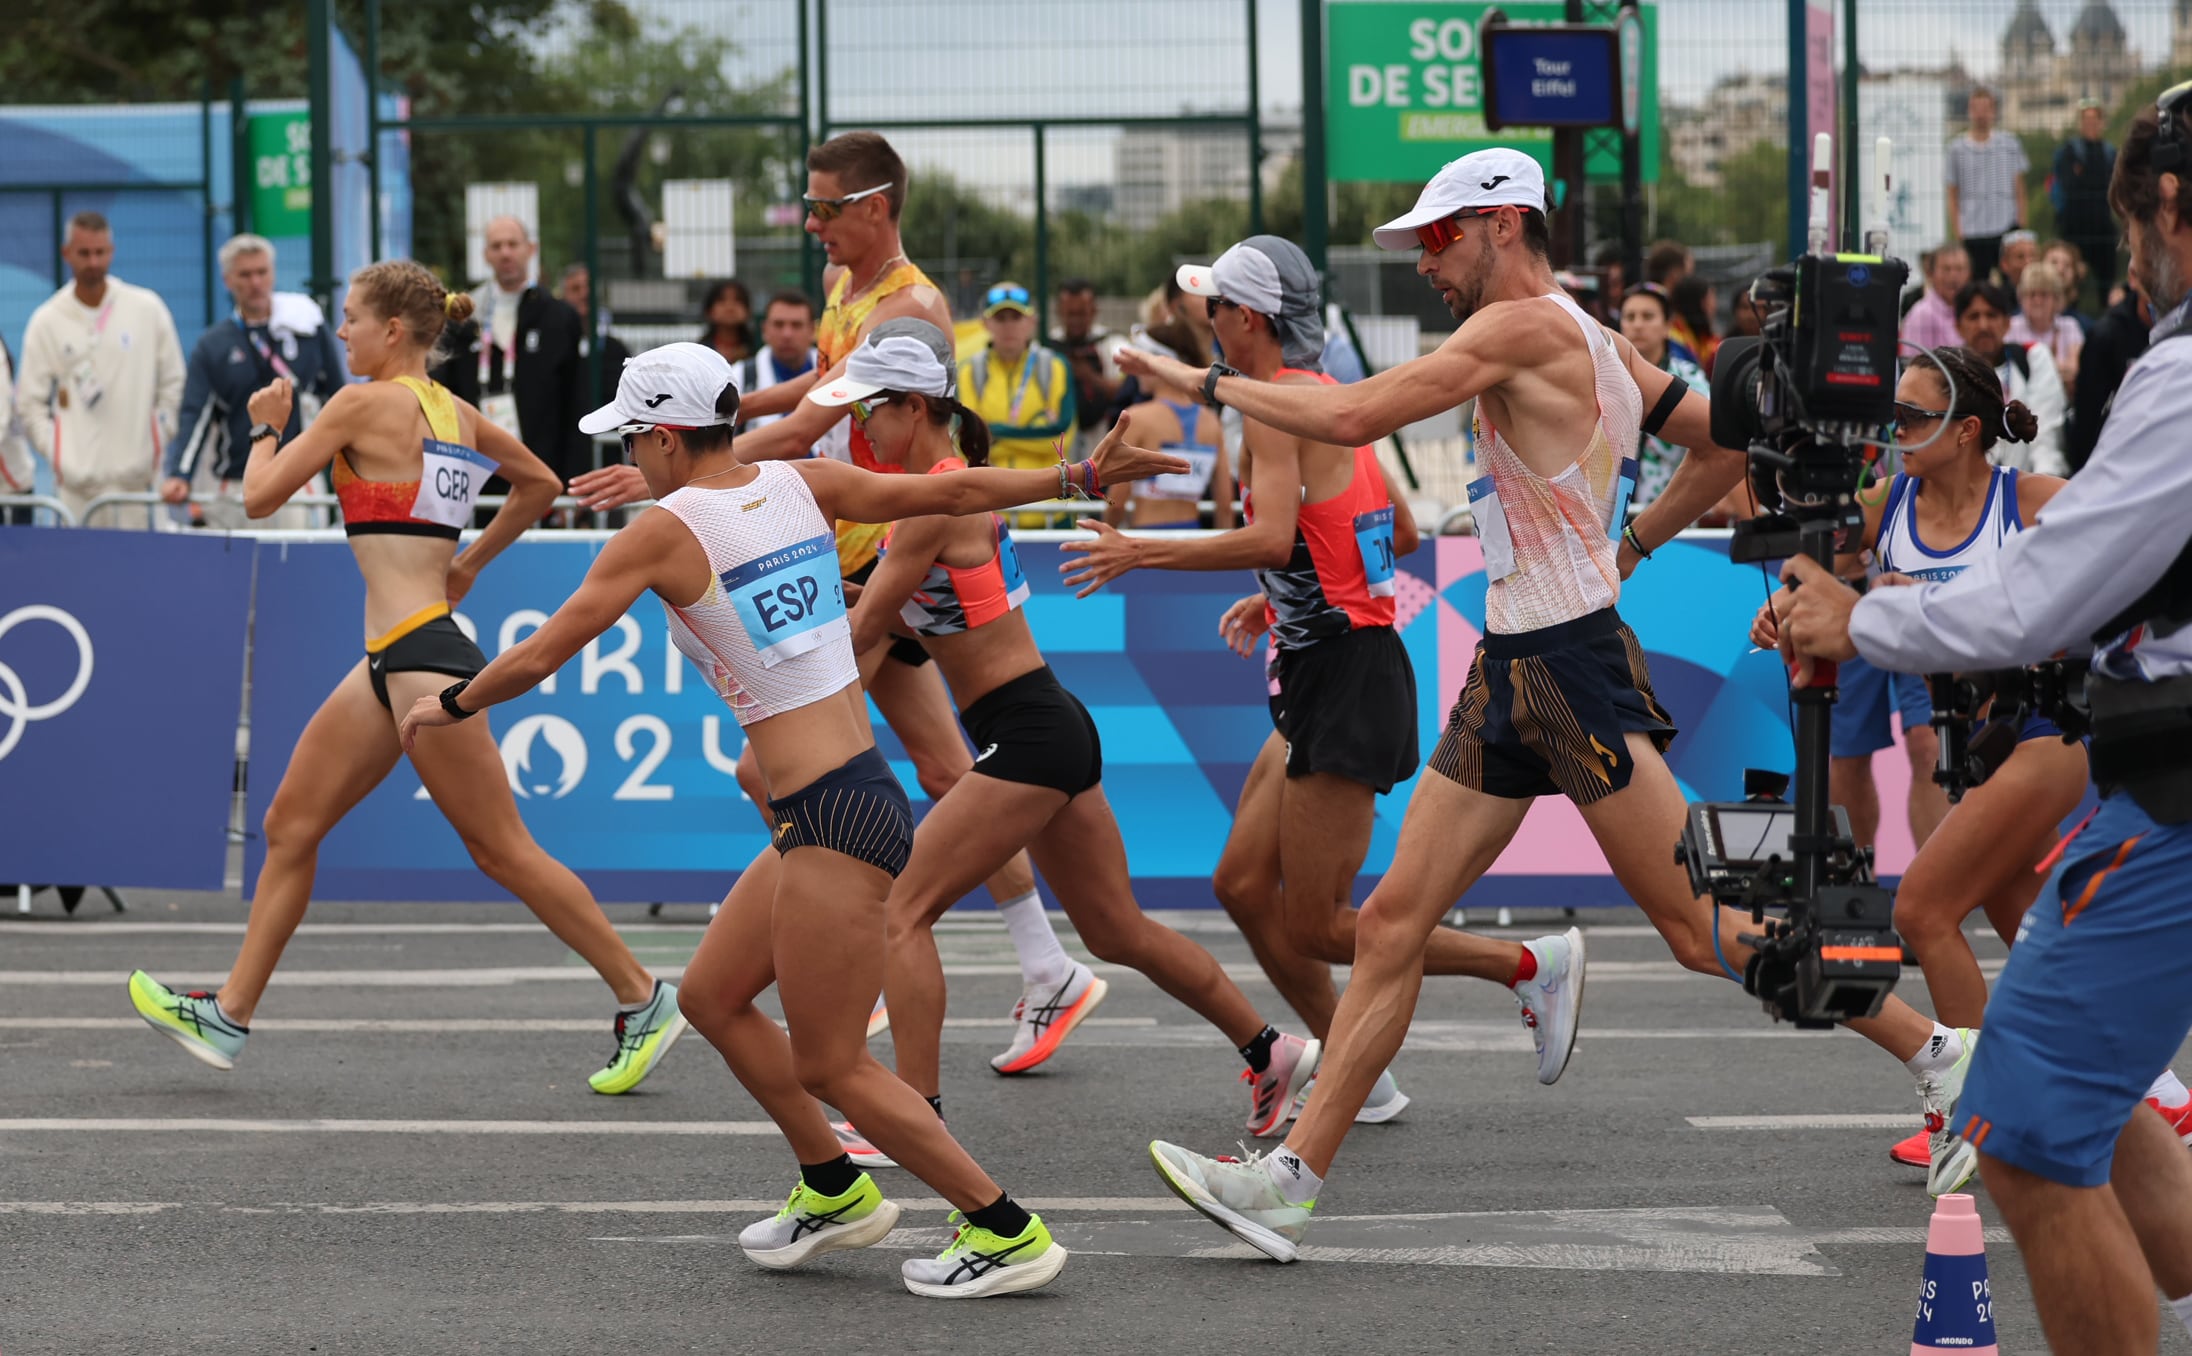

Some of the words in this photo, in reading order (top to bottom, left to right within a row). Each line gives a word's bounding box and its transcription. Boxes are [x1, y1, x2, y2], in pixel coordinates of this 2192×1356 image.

[1532, 57, 1571, 76] Tour
[1349, 65, 1410, 107] DE
[1531, 79, 1575, 97] Eiffel
[435, 466, 470, 503] GER
[758, 553, 791, 572] PARIS
[791, 543, 818, 560] 2024
[752, 575, 819, 633] ESP
